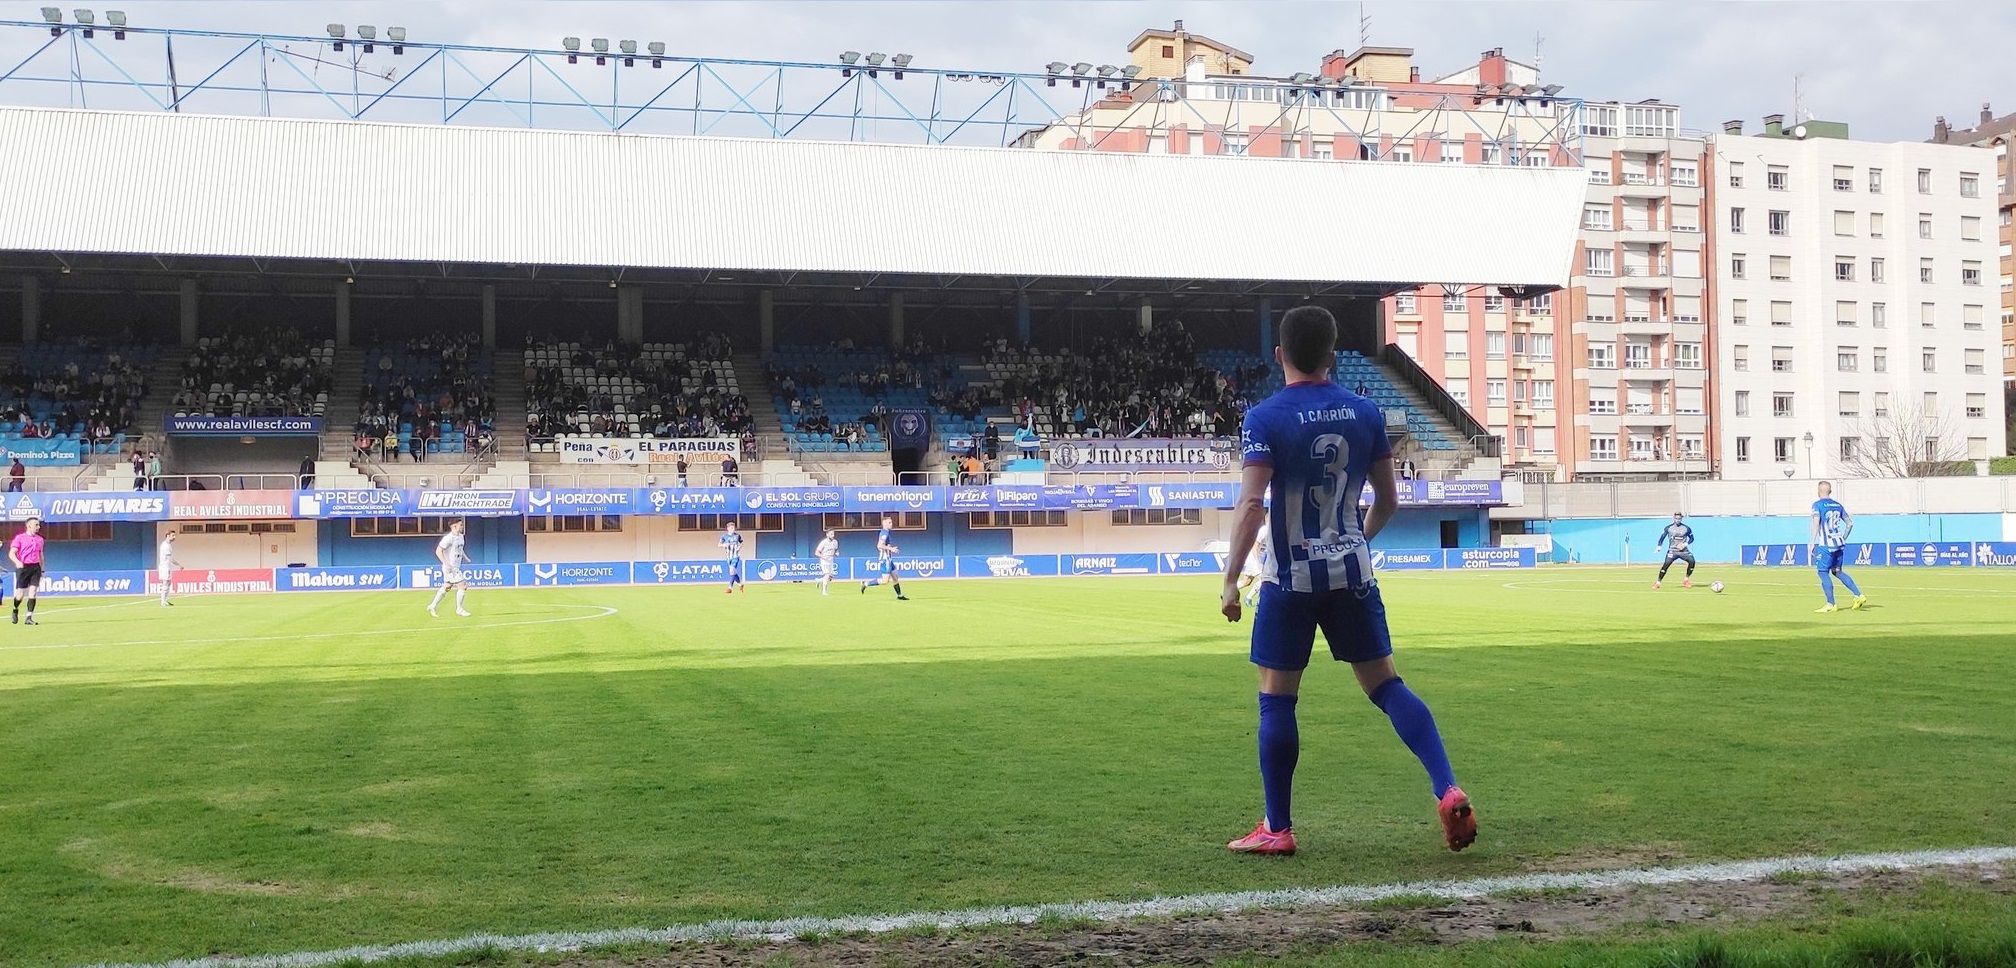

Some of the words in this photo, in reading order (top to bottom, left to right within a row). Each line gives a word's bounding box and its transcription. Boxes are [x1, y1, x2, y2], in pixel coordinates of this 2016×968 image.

[1309, 404, 1356, 422] CARRIÓN
[174, 419, 312, 430] www.realavilescf.com
[564, 442, 593, 452] Peña
[639, 442, 655, 452] EL
[659, 441, 736, 452] PARAGUAS
[7, 450, 49, 459] Domino's
[50, 451, 75, 459] Pizza
[1085, 443, 1206, 464] Indeseables
[1309, 433, 1350, 509] 3
[1395, 482, 1412, 493] illa
[1444, 483, 1490, 493] europreven
[325, 491, 402, 504] PRECUSA
[421, 493, 453, 507] IMT
[555, 493, 628, 504] HORIZONTE
[671, 494, 725, 503] LATAM
[765, 493, 778, 501] EL
[780, 493, 801, 501] SOL
[803, 492, 840, 501] GRUPO
[858, 490, 933, 502] fanemotional
[1168, 491, 1225, 500] SANIASTUR
[75, 498, 164, 514] NEVARES
[174, 506, 198, 516] REAL
[200, 505, 231, 516] AVILES
[233, 504, 288, 516] INDUSTRIAL
[1312, 539, 1365, 555] PRECUSA
[1076, 557, 1116, 569] ARNAIZ
[1387, 555, 1432, 563] FRESAMEX
[1462, 560, 1490, 568] .com
[1989, 554, 2016, 565] TALLO
[672, 565, 723, 575] LATAM
[779, 563, 790, 571] EL
[791, 563, 807, 571] SOL
[809, 562, 838, 571] GRO
[865, 559, 944, 571] fanmotional
[434, 569, 502, 581] PCUSA
[561, 567, 613, 577] HORIZONTE
[993, 567, 1031, 577] SUVAL
[291, 571, 356, 587] Mahou
[359, 573, 383, 585] SIN
[104, 579, 131, 591] SIN
[149, 582, 175, 594] REL
[177, 582, 212, 593] AVILES
[213, 581, 273, 592] INDUSTRIAL
